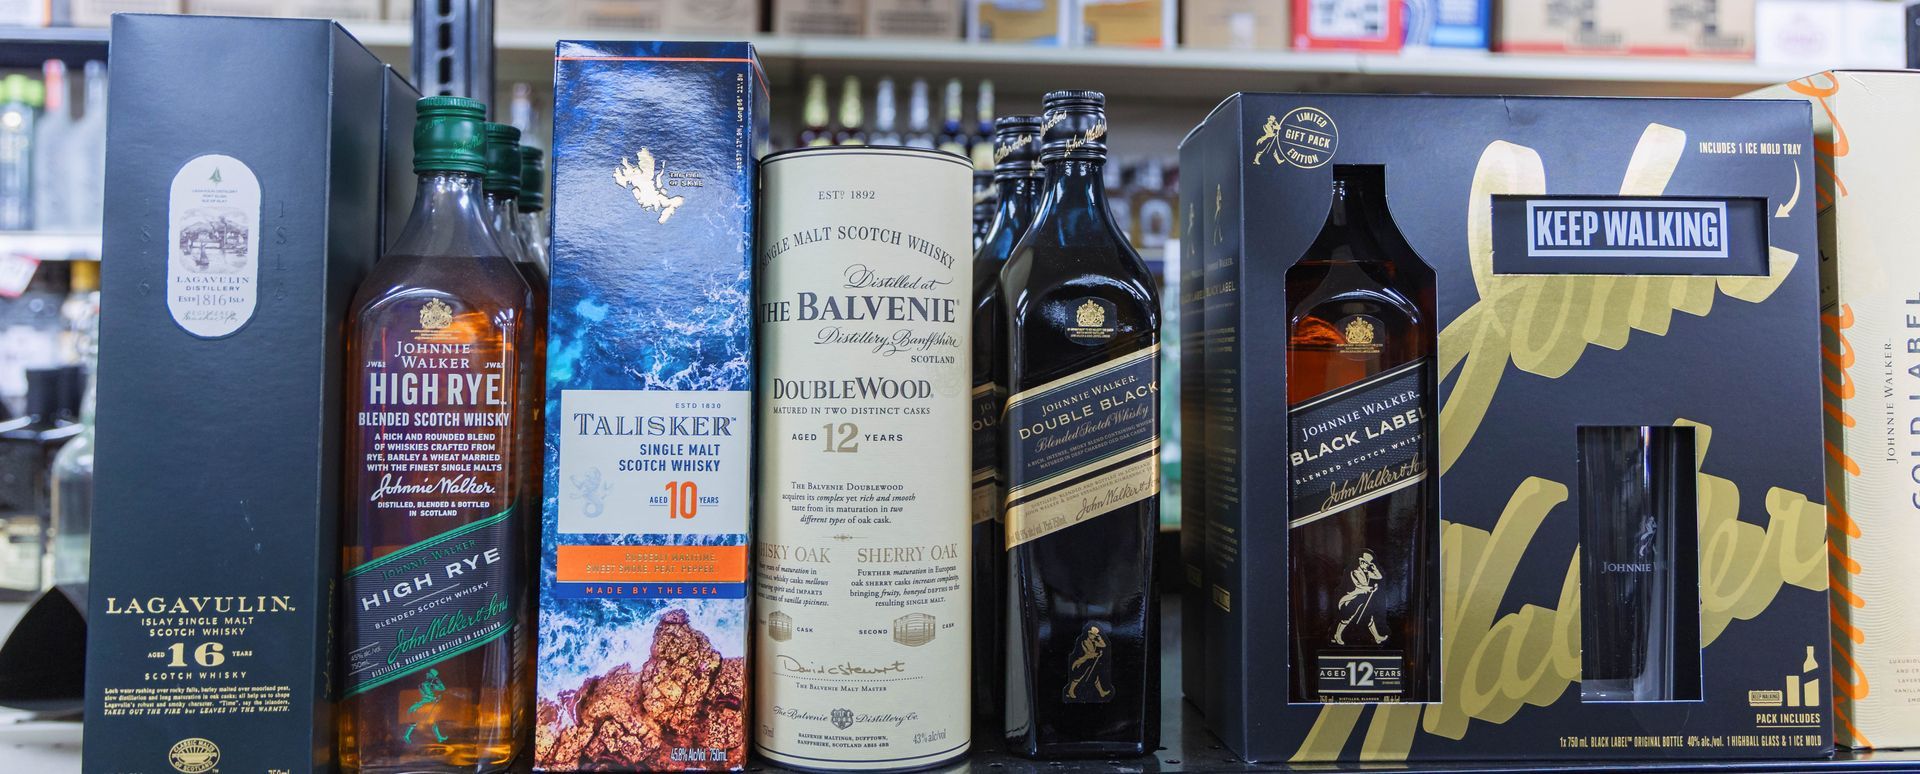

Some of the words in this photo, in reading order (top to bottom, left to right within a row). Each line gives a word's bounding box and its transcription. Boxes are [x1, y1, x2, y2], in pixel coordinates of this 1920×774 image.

[1296, 112, 1328, 128] LIMITED
[1285, 129, 1305, 142] GIFT
[1308, 135, 1331, 148] PACK
[1287, 148, 1319, 164] EDITION
[1699, 142, 1736, 154] INCLUDES
[1739, 142, 1743, 154] 1
[1745, 142, 1757, 154] ICE
[1760, 143, 1781, 155] MOLD
[1783, 143, 1802, 155] TRAY
[850, 190, 875, 200] 1892
[1537, 211, 1599, 246] KEEP
[1603, 210, 1719, 247] WALKING
[793, 227, 831, 247] MALT
[837, 226, 901, 245] SCOTCH
[908, 235, 955, 269] WHISKY
[176, 276, 249, 284] LAGAVULIN
[843, 264, 921, 290] Distilled
[761, 301, 790, 323] THE
[797, 292, 956, 323] BALVENIE
[394, 341, 471, 358] JOHNNIE
[401, 355, 470, 369] WALKER
[911, 356, 954, 364] SCOTLAND
[370, 372, 438, 406] HIGH
[773, 407, 807, 415] MATURED
[824, 407, 847, 415] TWO
[851, 407, 900, 415] DISTINCT
[1018, 404, 1094, 440] DOUBLE
[1100, 380, 1159, 411] BLACK
[1042, 390, 1090, 418] JOHNNIE
[358, 412, 409, 426] BLENDED
[414, 412, 459, 427] SCOTCH
[464, 412, 510, 426] WHISKY
[1034, 424, 1080, 453] Blended
[1078, 413, 1112, 437] Scotch
[1110, 403, 1149, 427] Whisky
[1302, 411, 1361, 442] JOHNNIE
[375, 433, 381, 441] A
[383, 433, 402, 441] RICH
[405, 433, 422, 441] AND
[425, 433, 465, 441] ROUNDED
[467, 433, 496, 441] BLEND
[822, 422, 859, 453] 12
[1886, 401, 1898, 464] JOHNNIE
[374, 443, 385, 451] OF
[387, 443, 429, 451] WHISKIES
[431, 443, 469, 451] CRAFTED
[471, 443, 496, 451] FROM
[640, 444, 683, 456] SINGLE
[689, 444, 720, 456] MALT
[1290, 431, 1361, 466] BLACK
[367, 453, 385, 462] RYE,
[387, 453, 420, 461] BARLEY
[422, 453, 428, 461] &
[430, 453, 459, 461] WHEAT
[461, 453, 500, 461] MARRIED
[619, 459, 666, 472] SCOTCH
[671, 459, 720, 472] WHISKY
[1296, 464, 1342, 485] BLENDED
[1347, 448, 1387, 466] SCOTCH
[367, 464, 389, 472] WITH
[390, 464, 407, 472] THE
[409, 464, 439, 472] FINEST
[441, 464, 471, 472] SINGLE
[473, 464, 502, 472] MALTS
[370, 473, 434, 501] Johnnie
[791, 481, 805, 490] THE
[807, 482, 844, 491] BALVENIE
[846, 483, 904, 491] DOUBLEWOOD
[377, 501, 416, 509] DISTILLED,
[649, 496, 668, 504] AGED
[665, 481, 697, 519] 10
[699, 496, 719, 504] YEARS
[782, 494, 805, 503] acquires
[816, 494, 845, 503] complex
[859, 494, 875, 502] rich
[876, 494, 891, 502] and
[892, 494, 916, 502] smooth
[1320, 481, 1356, 513] John
[1076, 498, 1106, 522] John
[430, 539, 476, 561] WALKER
[857, 546, 926, 563] SHERRY
[930, 543, 958, 561] OAK
[1601, 562, 1651, 574] JOHNNIE
[361, 572, 433, 611] HIGH
[445, 547, 500, 579] RYE
[375, 609, 415, 629] BLENDED
[417, 595, 452, 613] SCOTCH
[454, 581, 489, 599] WHISKY
[141, 618, 173, 626] ISLAY
[178, 617, 218, 626] SINGLE
[224, 616, 254, 625] MALT
[149, 628, 195, 637] SCOTCH
[202, 627, 246, 636] WHISKY
[387, 627, 426, 665] John
[424, 609, 474, 642] Walker
[167, 641, 225, 667] 16
[144, 673, 193, 681] SCOTCH
[199, 671, 246, 680] WHISKY
[1346, 661, 1375, 686] 12
[1756, 714, 1778, 724] PACK
[1780, 714, 1821, 724] INCLUDES
